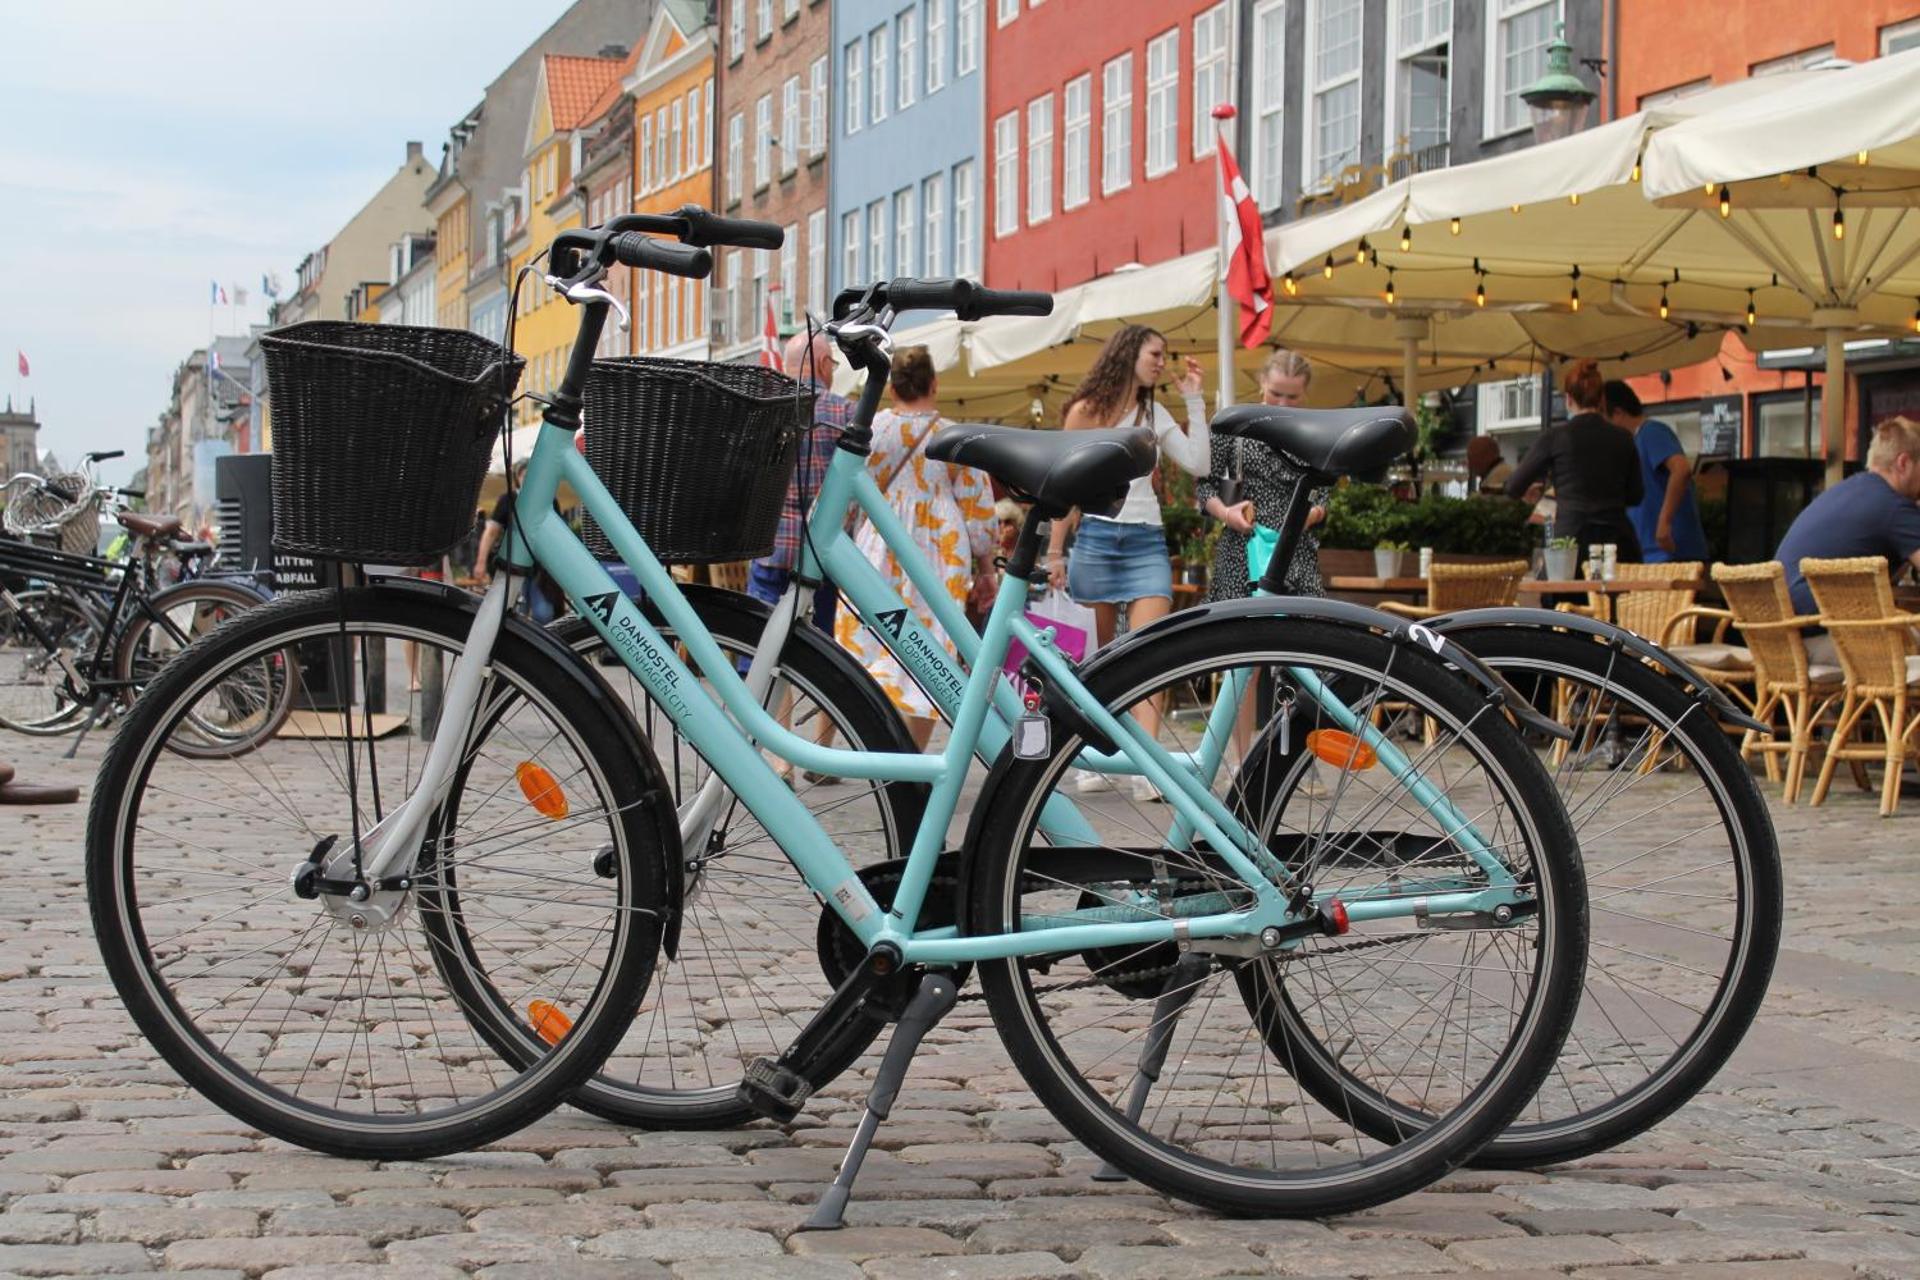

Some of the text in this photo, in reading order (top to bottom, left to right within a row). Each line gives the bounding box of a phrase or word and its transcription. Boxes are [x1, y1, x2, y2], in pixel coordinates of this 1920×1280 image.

[276, 572, 317, 584] ABFALL
[610, 625, 693, 718] COPENHAGEN CITY
[619, 616, 681, 689] DANHOSTEL
[900, 639, 957, 704] COPENHAGEN
[908, 631, 963, 697] DANHOSTEL
[1408, 624, 1446, 654] 2
